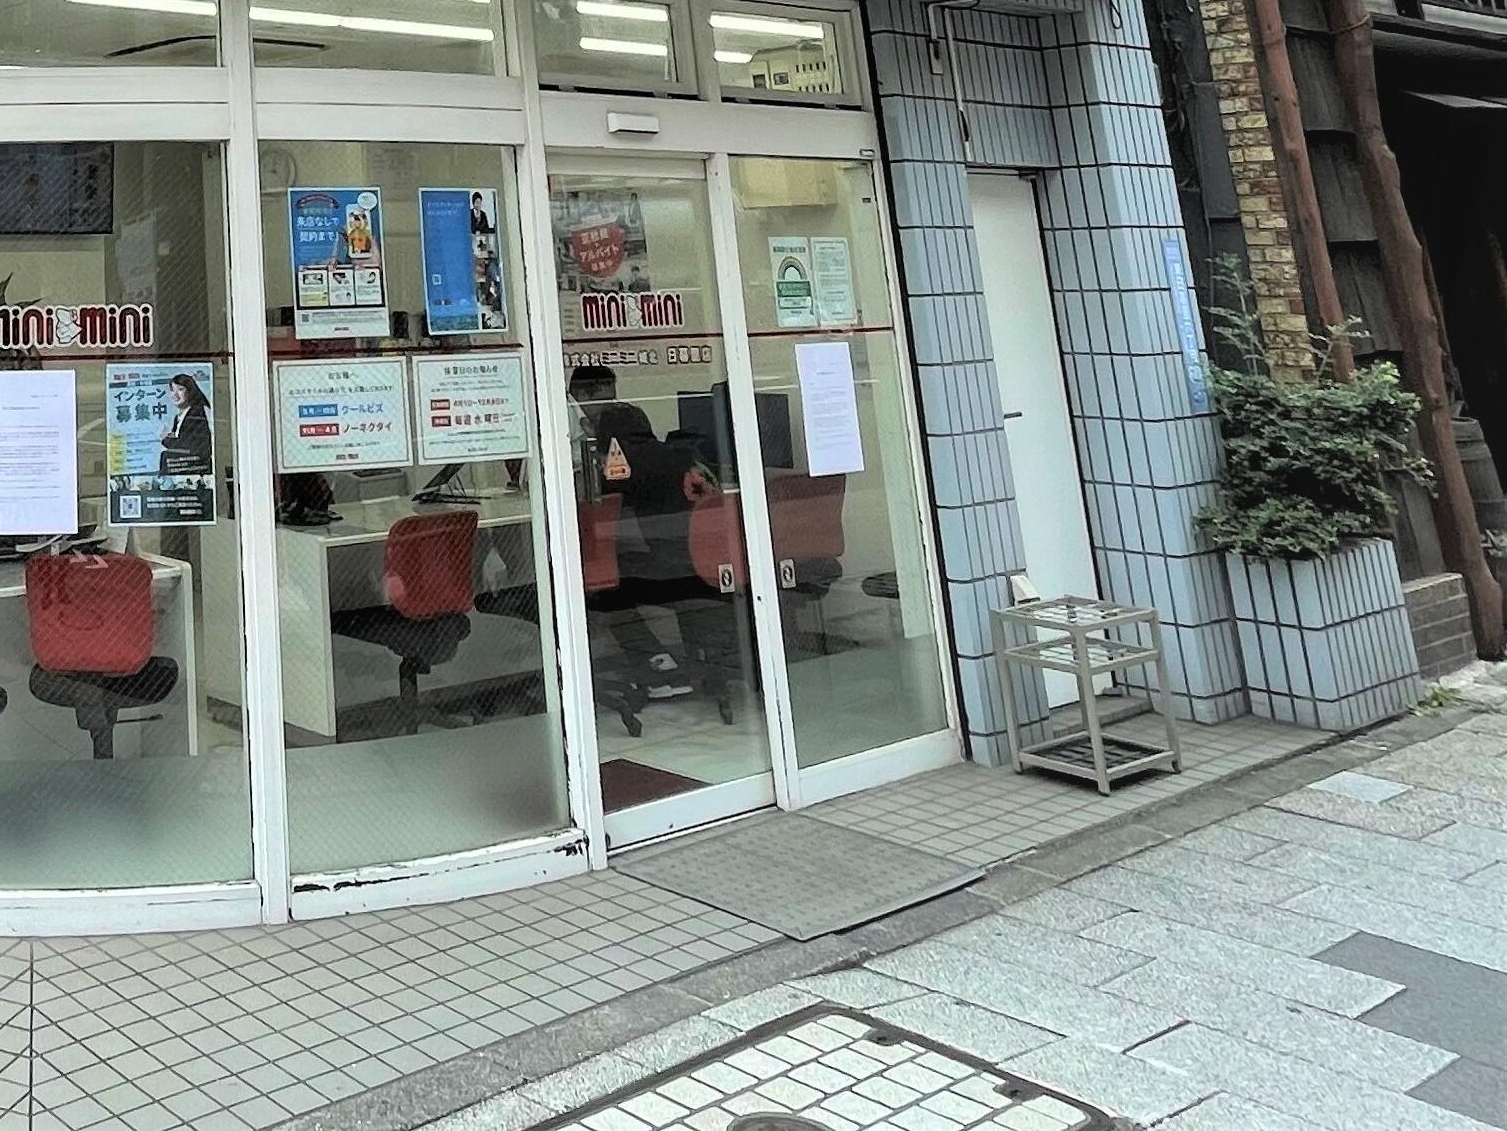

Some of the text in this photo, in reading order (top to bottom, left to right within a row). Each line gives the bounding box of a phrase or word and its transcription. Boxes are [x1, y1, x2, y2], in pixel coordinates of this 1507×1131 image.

[79, 306, 151, 345] mini
[582, 293, 683, 329] mini mini
[114, 388, 167, 402] インターン
[115, 401, 168, 423] 募集中
